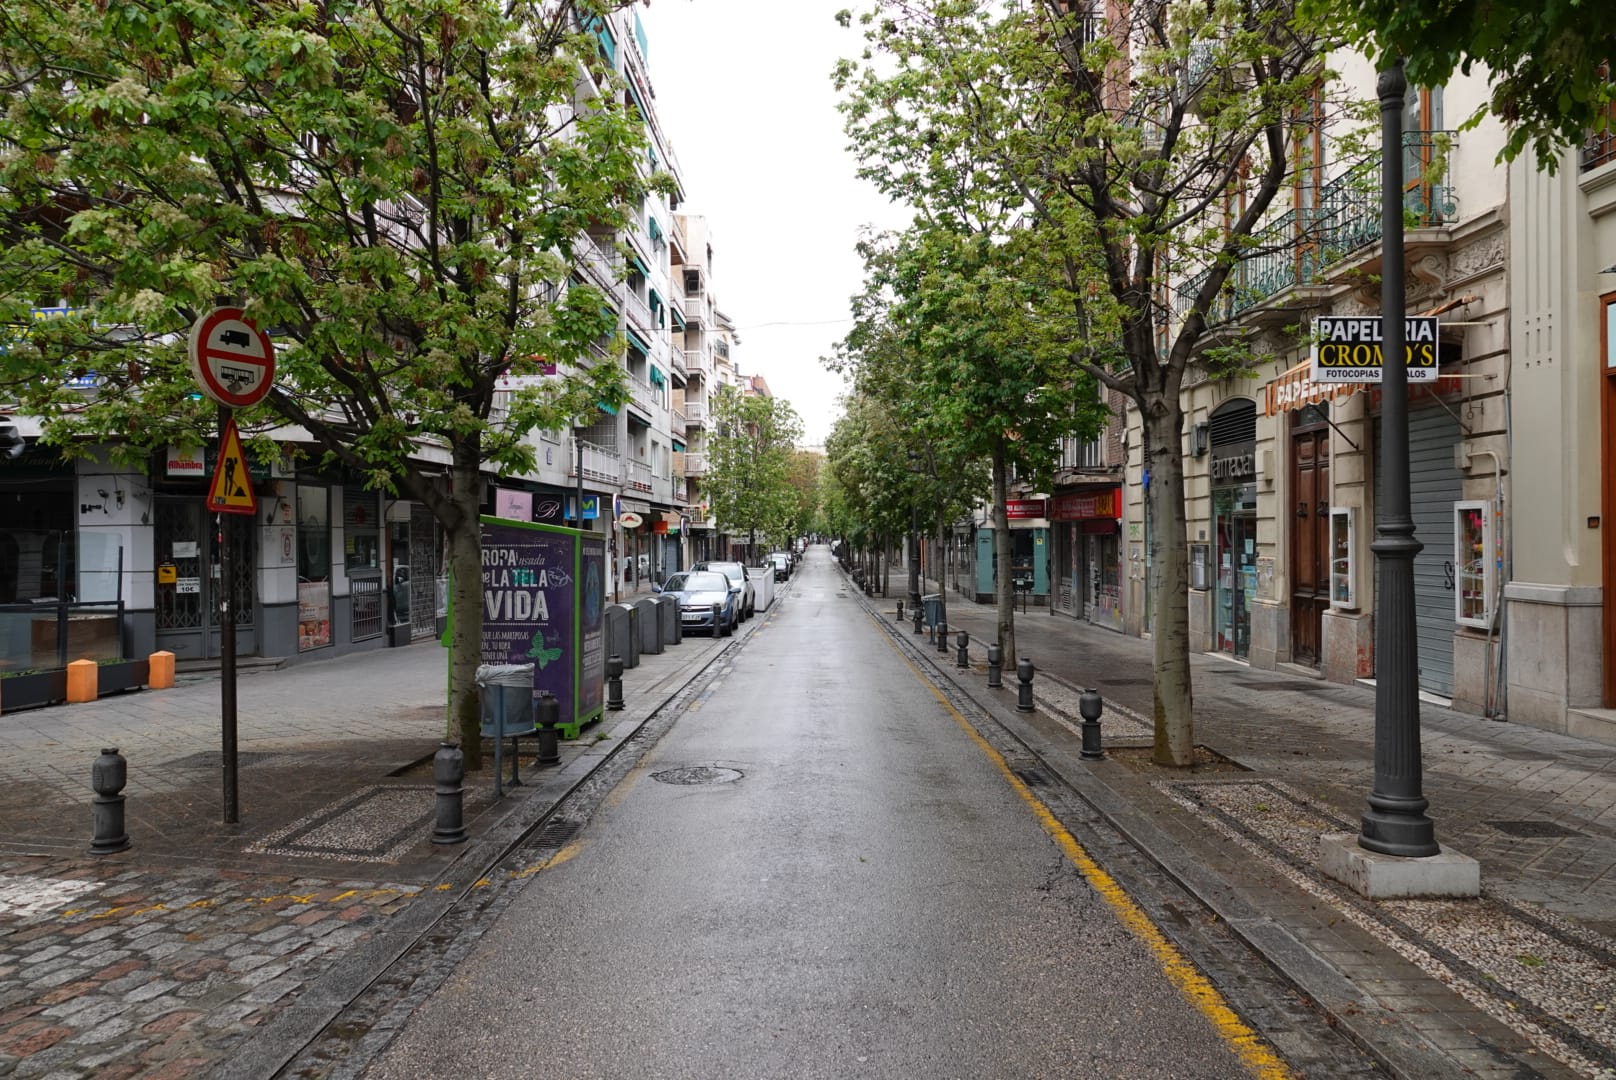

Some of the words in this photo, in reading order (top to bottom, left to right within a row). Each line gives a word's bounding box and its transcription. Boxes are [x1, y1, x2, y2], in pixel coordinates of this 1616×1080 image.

[1320, 320, 1433, 342] PAPELIA
[1326, 369, 1380, 378] FOTOCOPIAS
[167, 460, 203, 470] Alhambra
[481, 549, 517, 566] ROPA
[518, 553, 546, 566] usada
[491, 569, 510, 588] LA
[511, 568, 548, 588] TELA
[484, 590, 549, 621] VIDA
